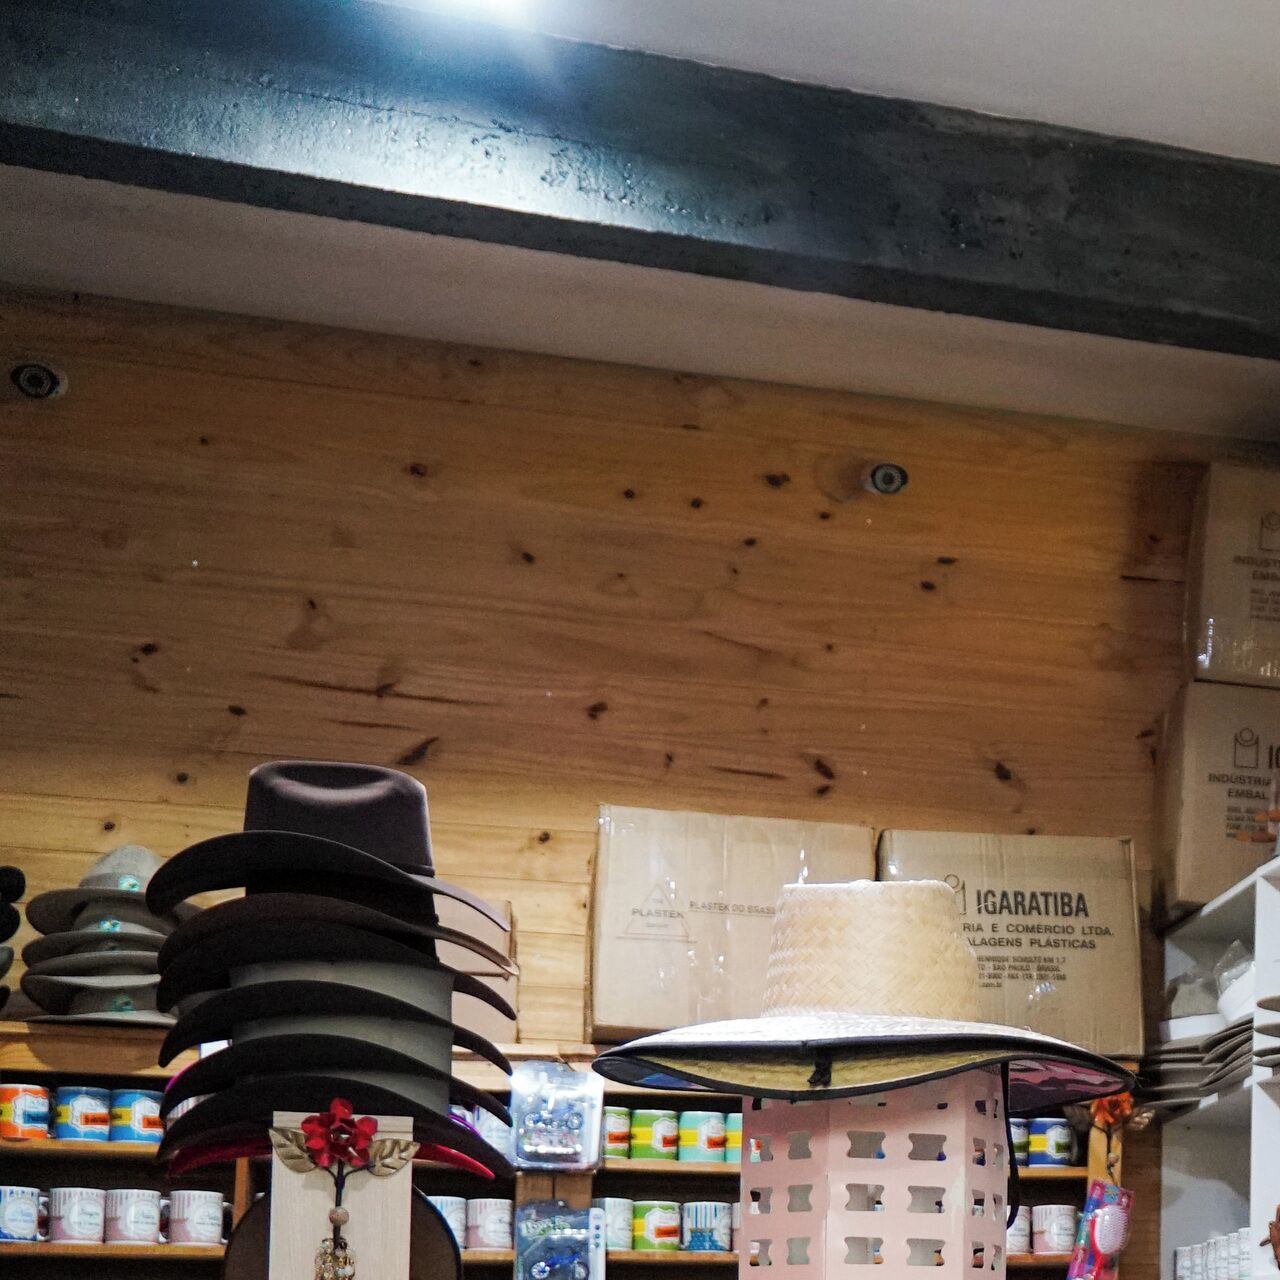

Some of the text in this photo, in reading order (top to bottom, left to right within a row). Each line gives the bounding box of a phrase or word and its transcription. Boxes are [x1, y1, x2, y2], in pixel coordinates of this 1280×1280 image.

[977, 890, 1089, 917] IGARATIBA
[632, 908, 684, 918] PLASTEK
[992, 924, 999, 932] E
[1082, 928, 1114, 936] LTDA.
